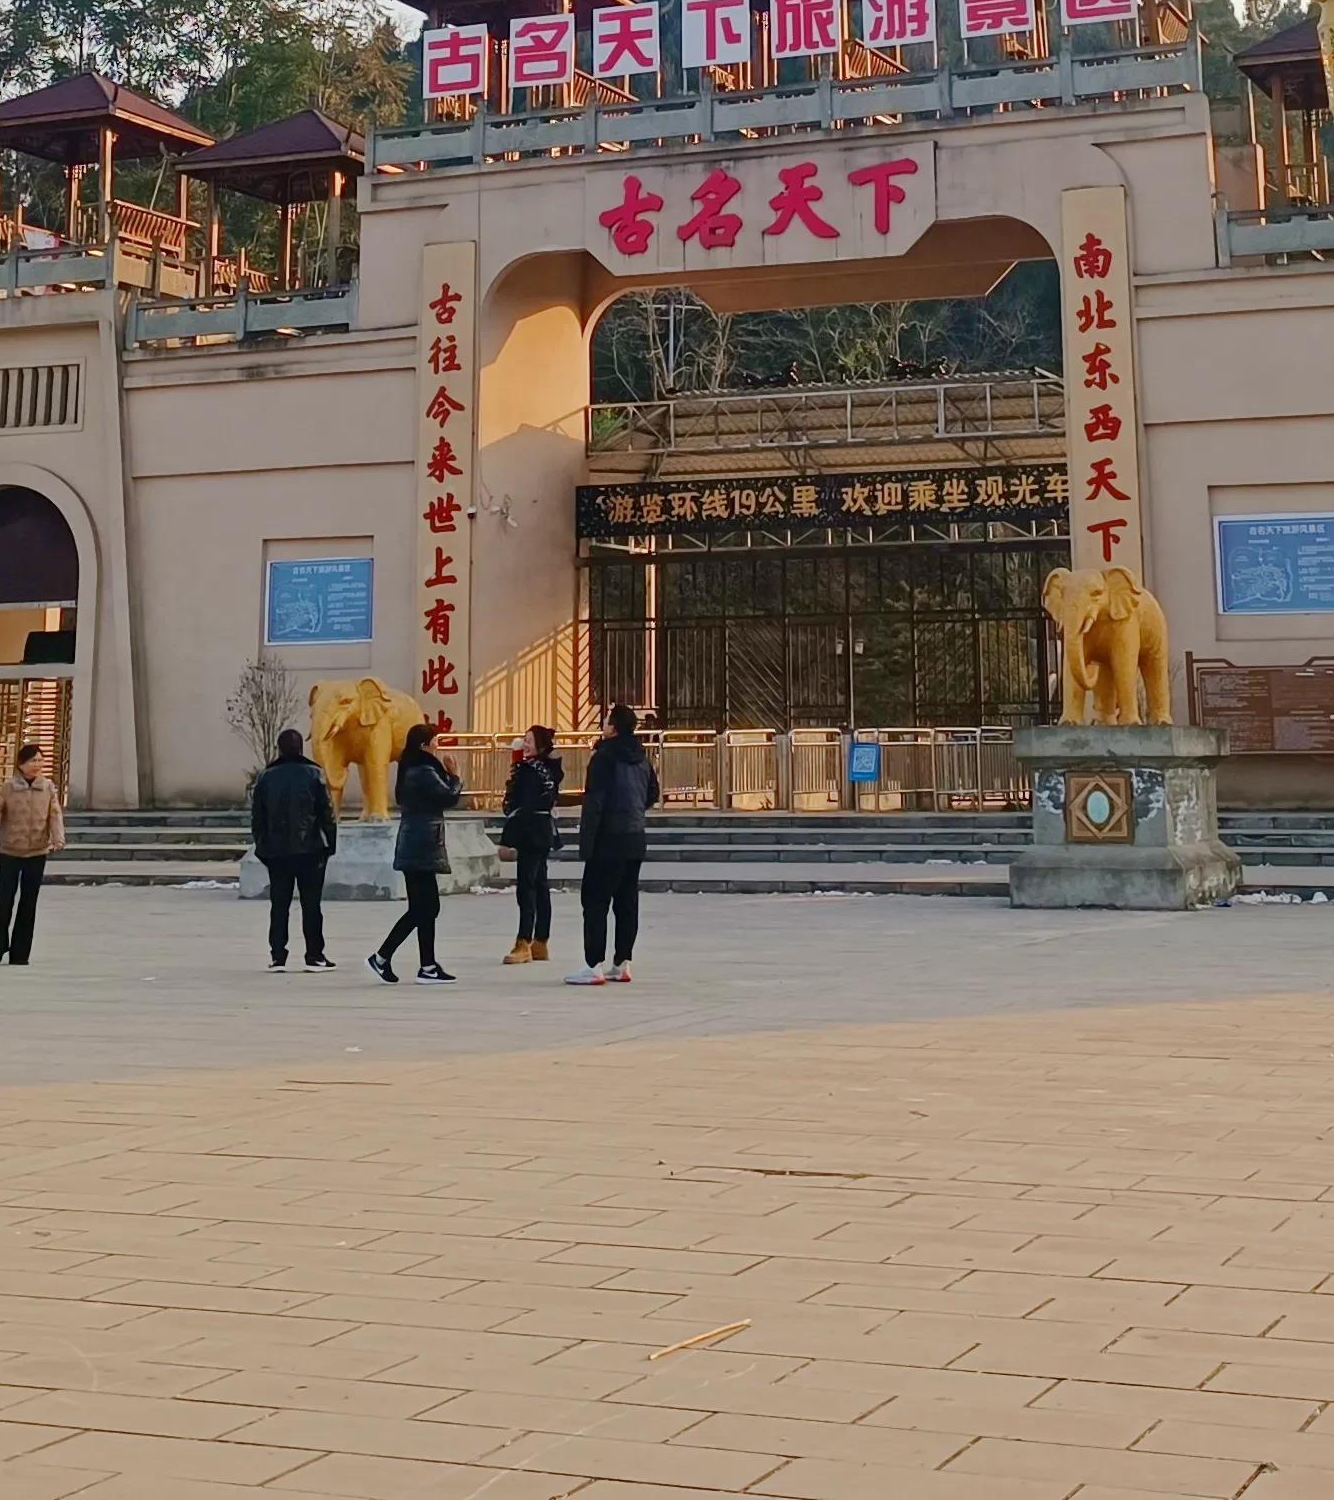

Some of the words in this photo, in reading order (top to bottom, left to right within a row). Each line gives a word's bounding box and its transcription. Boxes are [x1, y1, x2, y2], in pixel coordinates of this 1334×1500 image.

[598, 157, 918, 255] 古名天下
[1073, 232, 1131, 562] 南北东西天下
[607, 485, 821, 524] 游览环线19公里
[840, 473, 1070, 515] 欢迎乘坐观光车
